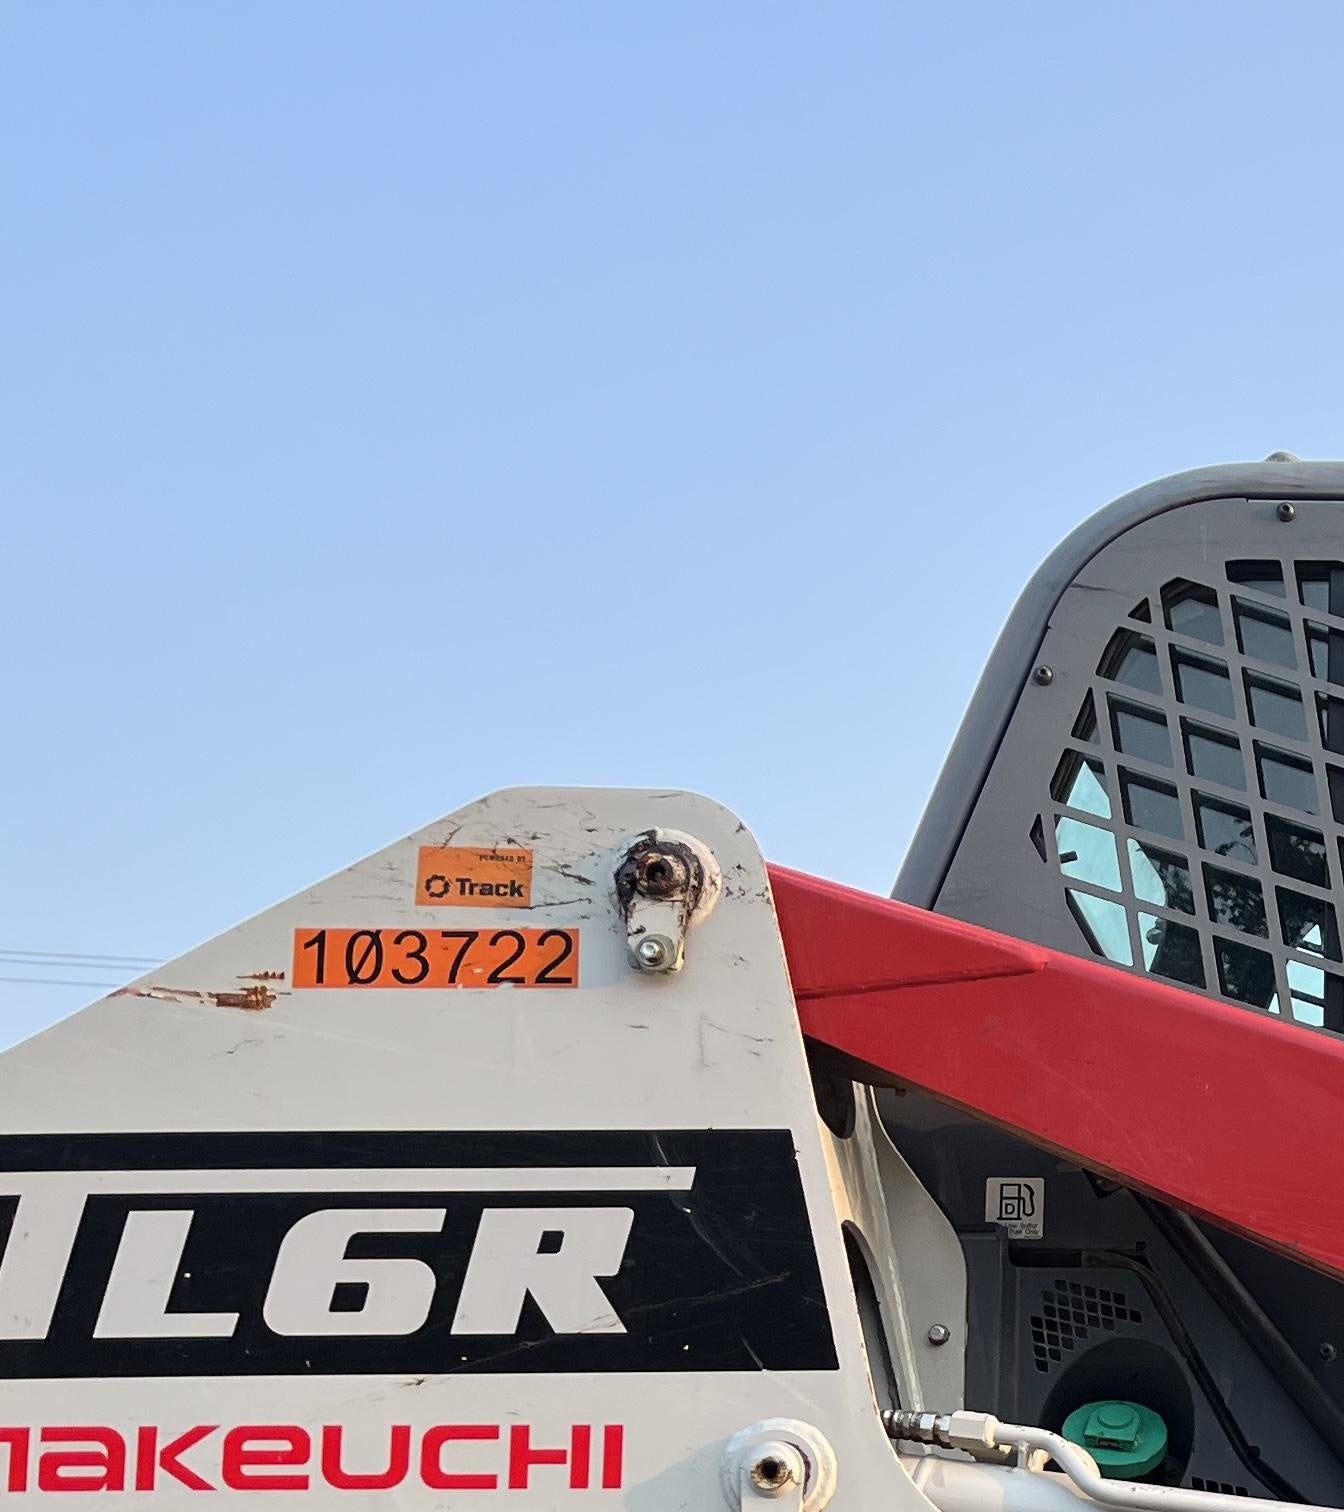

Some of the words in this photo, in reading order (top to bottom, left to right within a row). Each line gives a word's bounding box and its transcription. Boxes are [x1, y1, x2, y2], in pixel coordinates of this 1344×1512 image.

[456, 878, 525, 898] Track
[303, 929, 573, 985] 103722
[0, 1166, 697, 1341] TL6R
